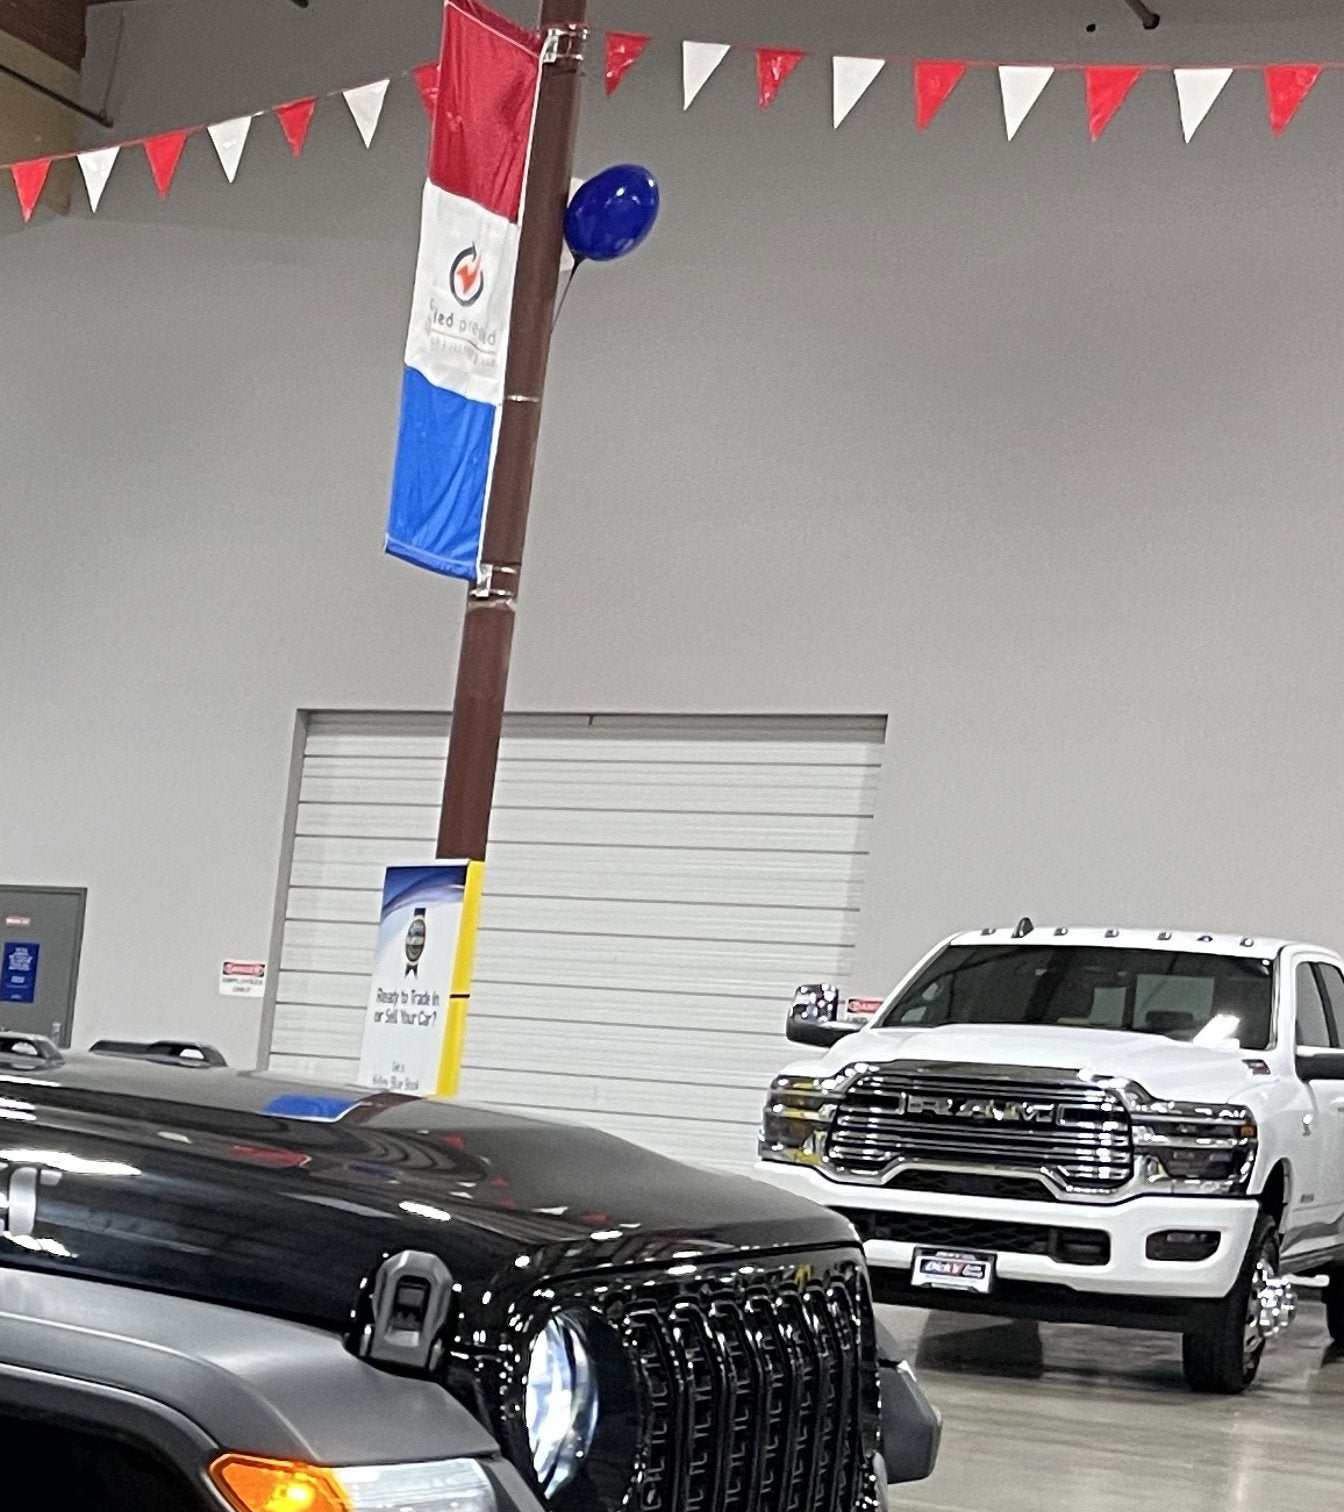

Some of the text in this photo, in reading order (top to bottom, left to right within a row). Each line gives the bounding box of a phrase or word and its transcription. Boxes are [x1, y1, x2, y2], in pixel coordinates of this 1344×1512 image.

[375, 987, 399, 1008] Ready
[410, 989, 431, 1006] Trade
[385, 1008, 399, 1024] Sell
[400, 1008, 417, 1025] Your
[418, 1010, 438, 1027] Car?
[908, 1094, 1054, 1122] RAM
